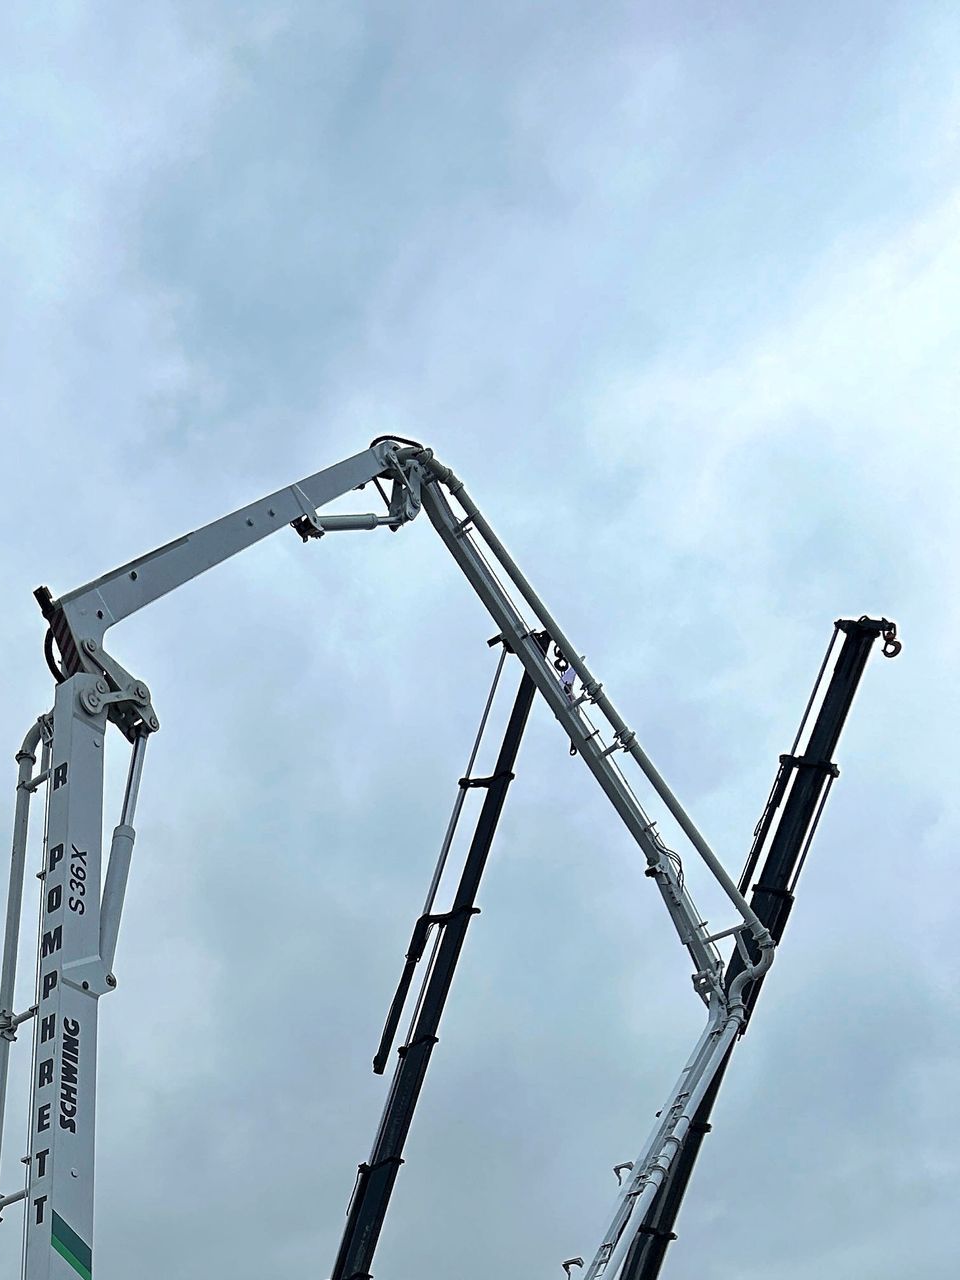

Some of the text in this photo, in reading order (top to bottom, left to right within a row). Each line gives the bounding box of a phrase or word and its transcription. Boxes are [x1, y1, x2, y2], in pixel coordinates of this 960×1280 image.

[52, 762, 68, 791] R
[33, 843, 64, 1226] POMPHRETT
[59, 1016, 80, 1134] SCHWING
